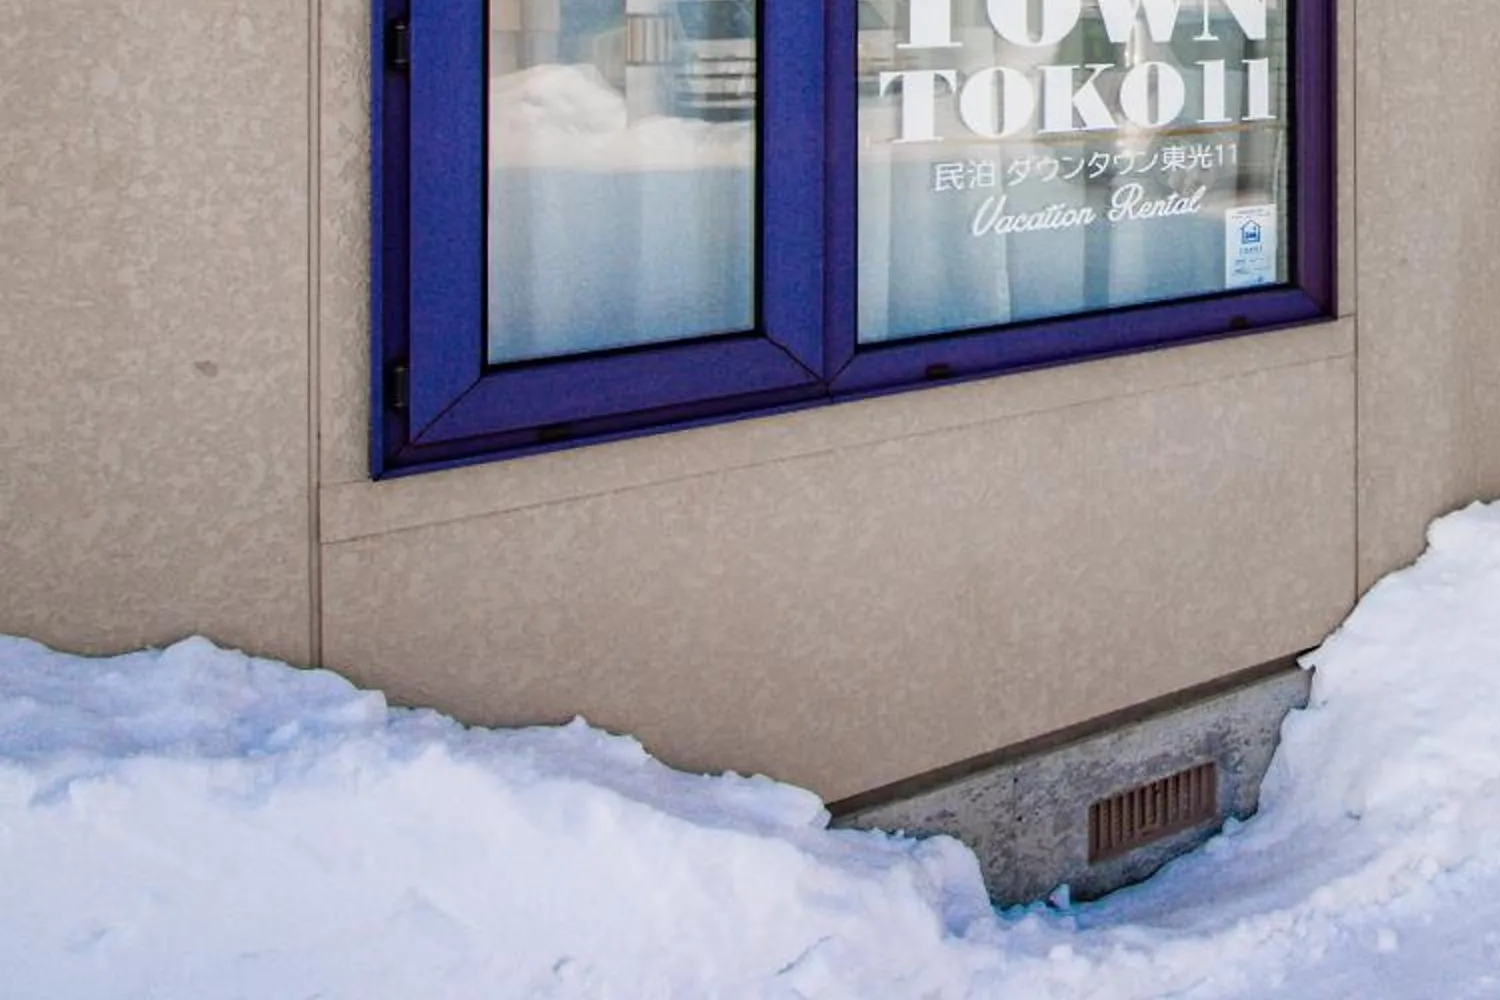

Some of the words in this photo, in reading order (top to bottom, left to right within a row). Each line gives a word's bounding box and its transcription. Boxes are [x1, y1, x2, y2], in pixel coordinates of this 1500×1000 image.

[935, 159, 996, 193] 民泊
[972, 195, 1097, 237] Vacation
[1107, 182, 1206, 222] Rental
